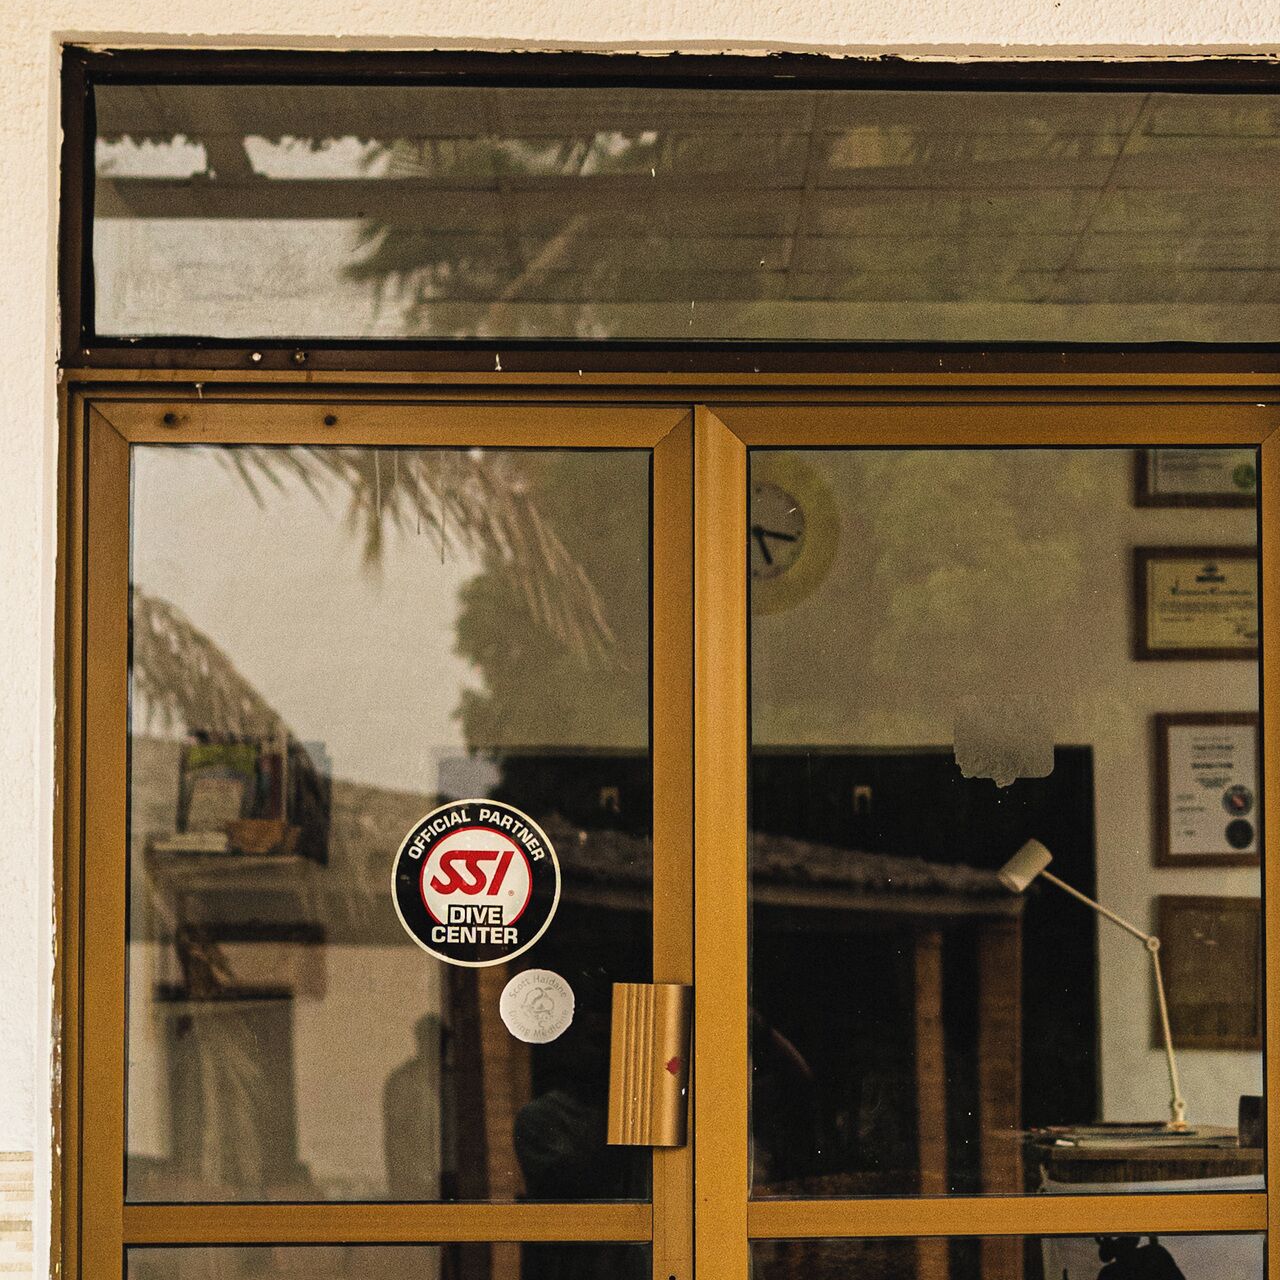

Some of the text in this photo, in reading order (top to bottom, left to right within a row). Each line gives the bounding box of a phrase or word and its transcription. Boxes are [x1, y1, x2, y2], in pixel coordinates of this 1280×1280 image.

[408, 808, 545, 861] OFFICIAL PARTNER
[430, 850, 515, 896] SSI
[450, 907, 500, 924] DIVE
[431, 926, 518, 944] CENTER
[509, 975, 567, 998] Scott Haldane
[533, 1009, 569, 1037] Medicine
